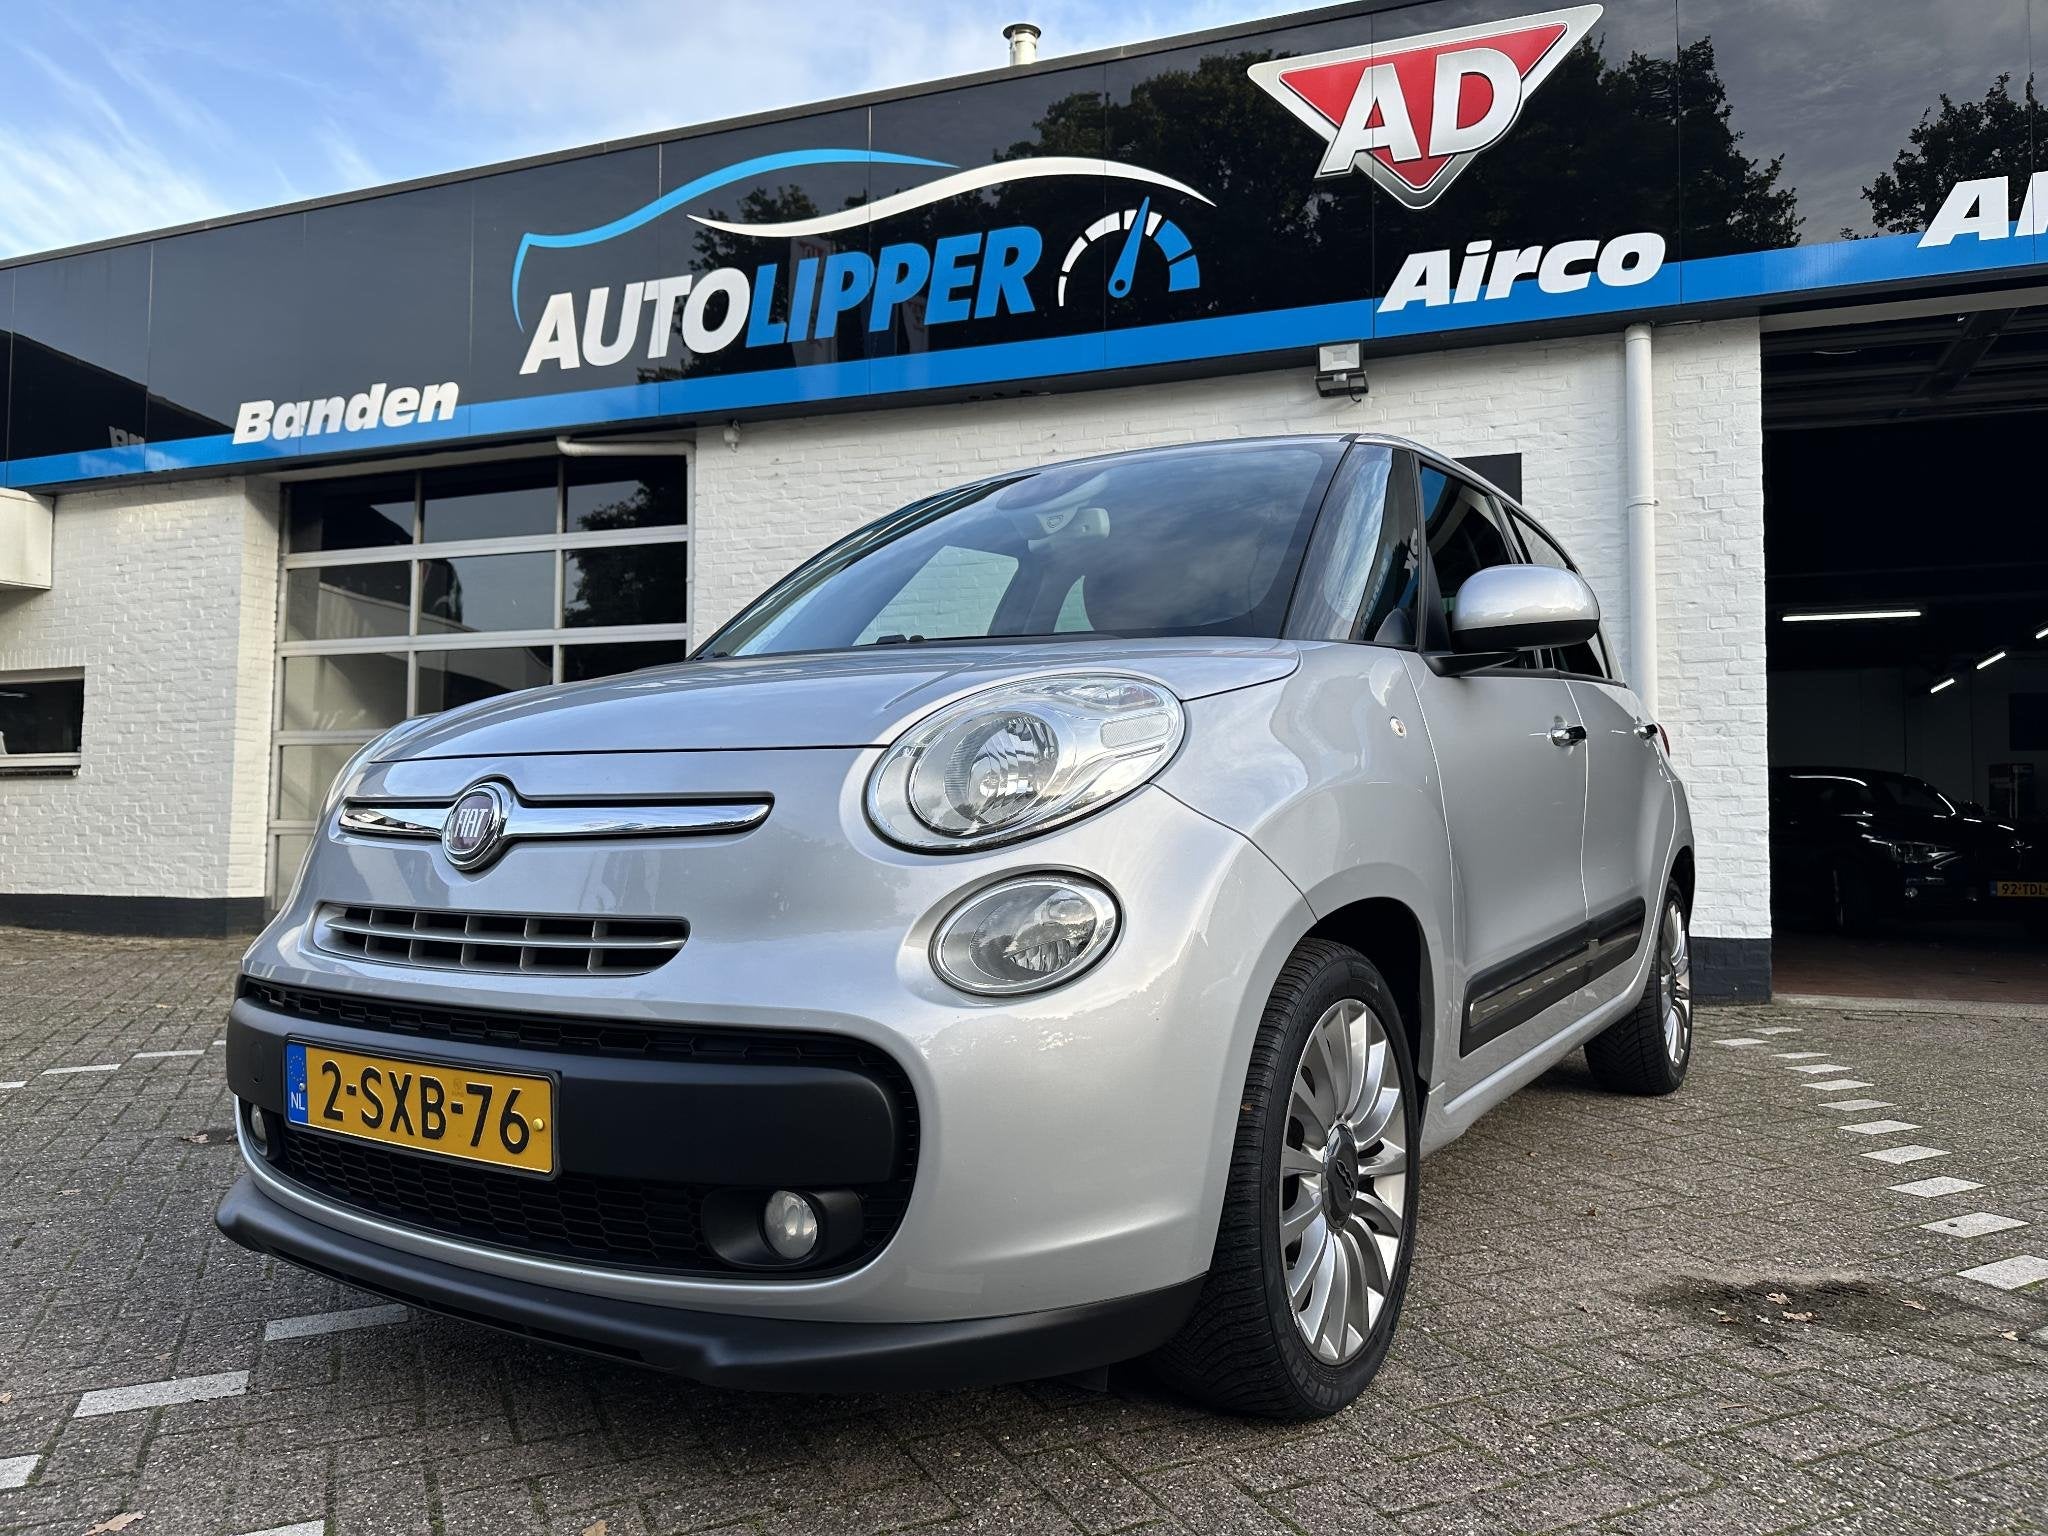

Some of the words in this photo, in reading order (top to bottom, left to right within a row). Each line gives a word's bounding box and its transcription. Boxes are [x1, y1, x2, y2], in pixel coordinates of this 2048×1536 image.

[1321, 47, 1522, 173] AD
[1376, 232, 1666, 313] Airco
[232, 381, 459, 444] Banden
[453, 808, 489, 838] FIAT
[290, 1092, 306, 1111] NL
[321, 1059, 530, 1154] 2-SXB-76
